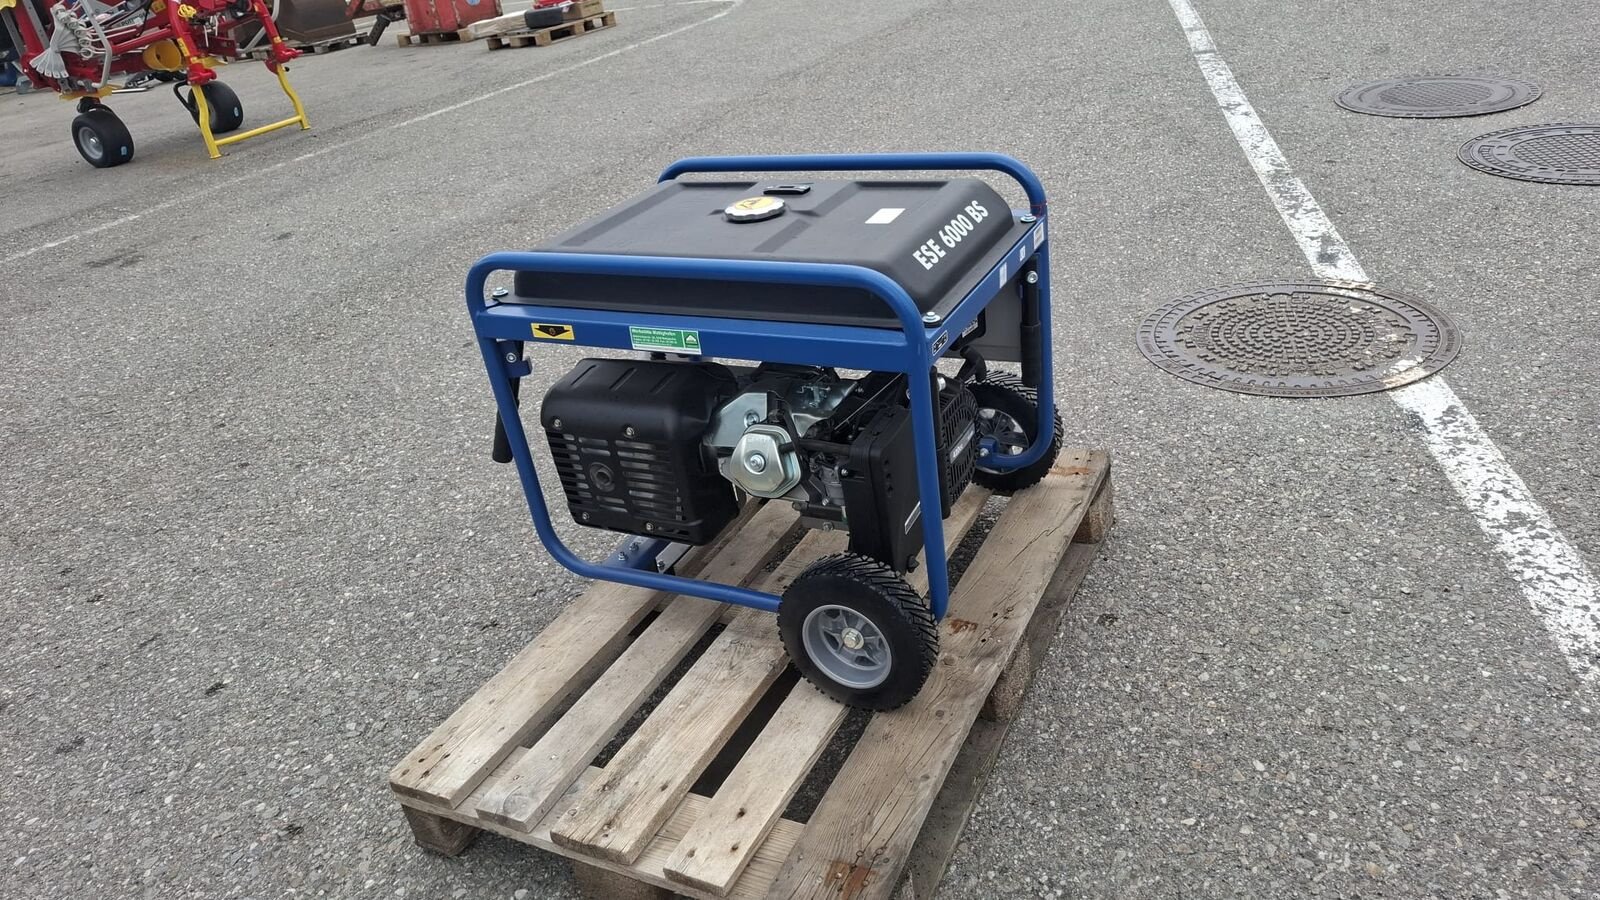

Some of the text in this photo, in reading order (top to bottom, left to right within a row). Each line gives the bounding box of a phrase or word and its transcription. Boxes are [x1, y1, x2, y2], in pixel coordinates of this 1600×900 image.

[912, 200, 989, 271] ESE 6000 BS
